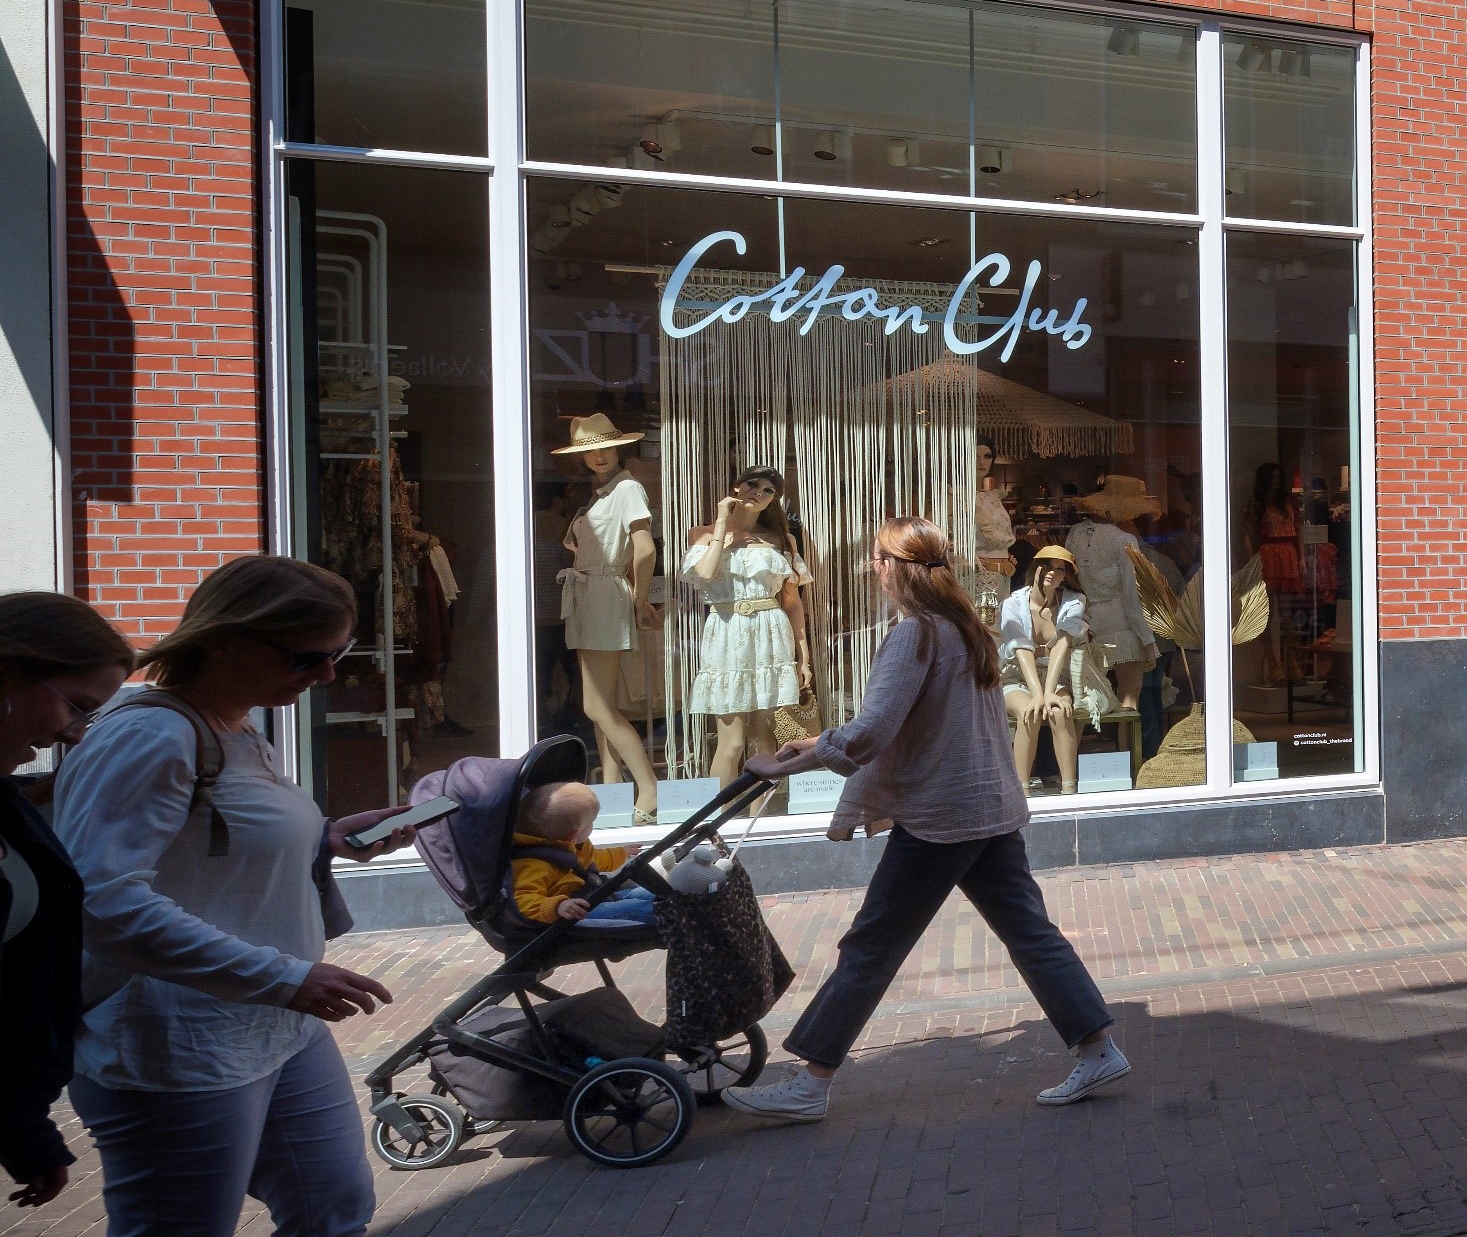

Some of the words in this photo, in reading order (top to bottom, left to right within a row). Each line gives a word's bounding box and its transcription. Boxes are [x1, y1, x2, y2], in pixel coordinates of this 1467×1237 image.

[660, 230, 930, 339] Cotton
[944, 252, 1092, 363] Club
[796, 779, 818, 787] where
